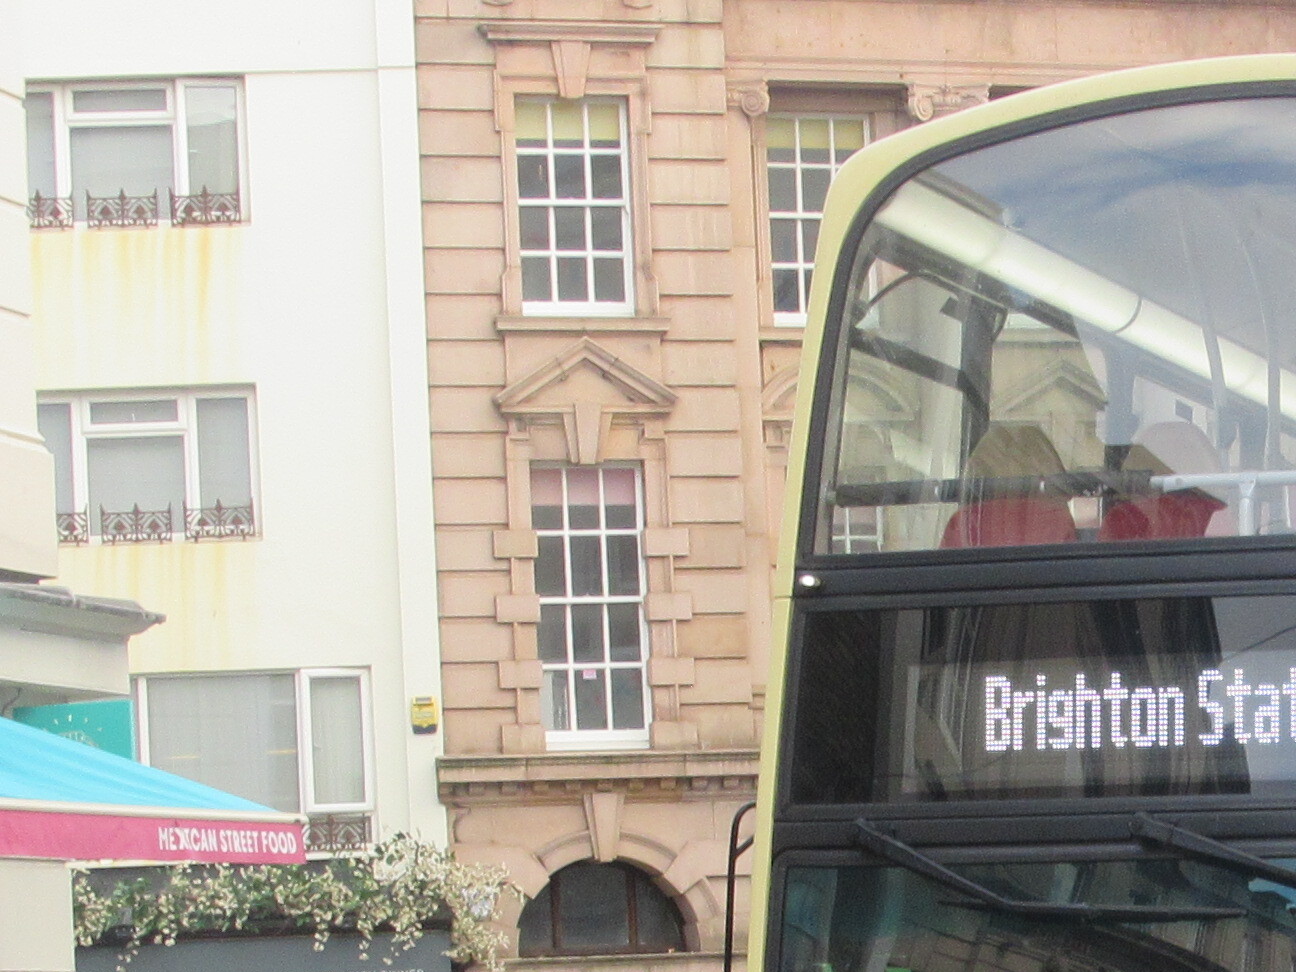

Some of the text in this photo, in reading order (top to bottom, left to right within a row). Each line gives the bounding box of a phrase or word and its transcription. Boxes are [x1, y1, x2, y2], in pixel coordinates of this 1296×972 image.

[984, 674, 1184, 753] Brighton
[219, 829, 259, 853] STREET
[261, 831, 297, 854] FOOD
